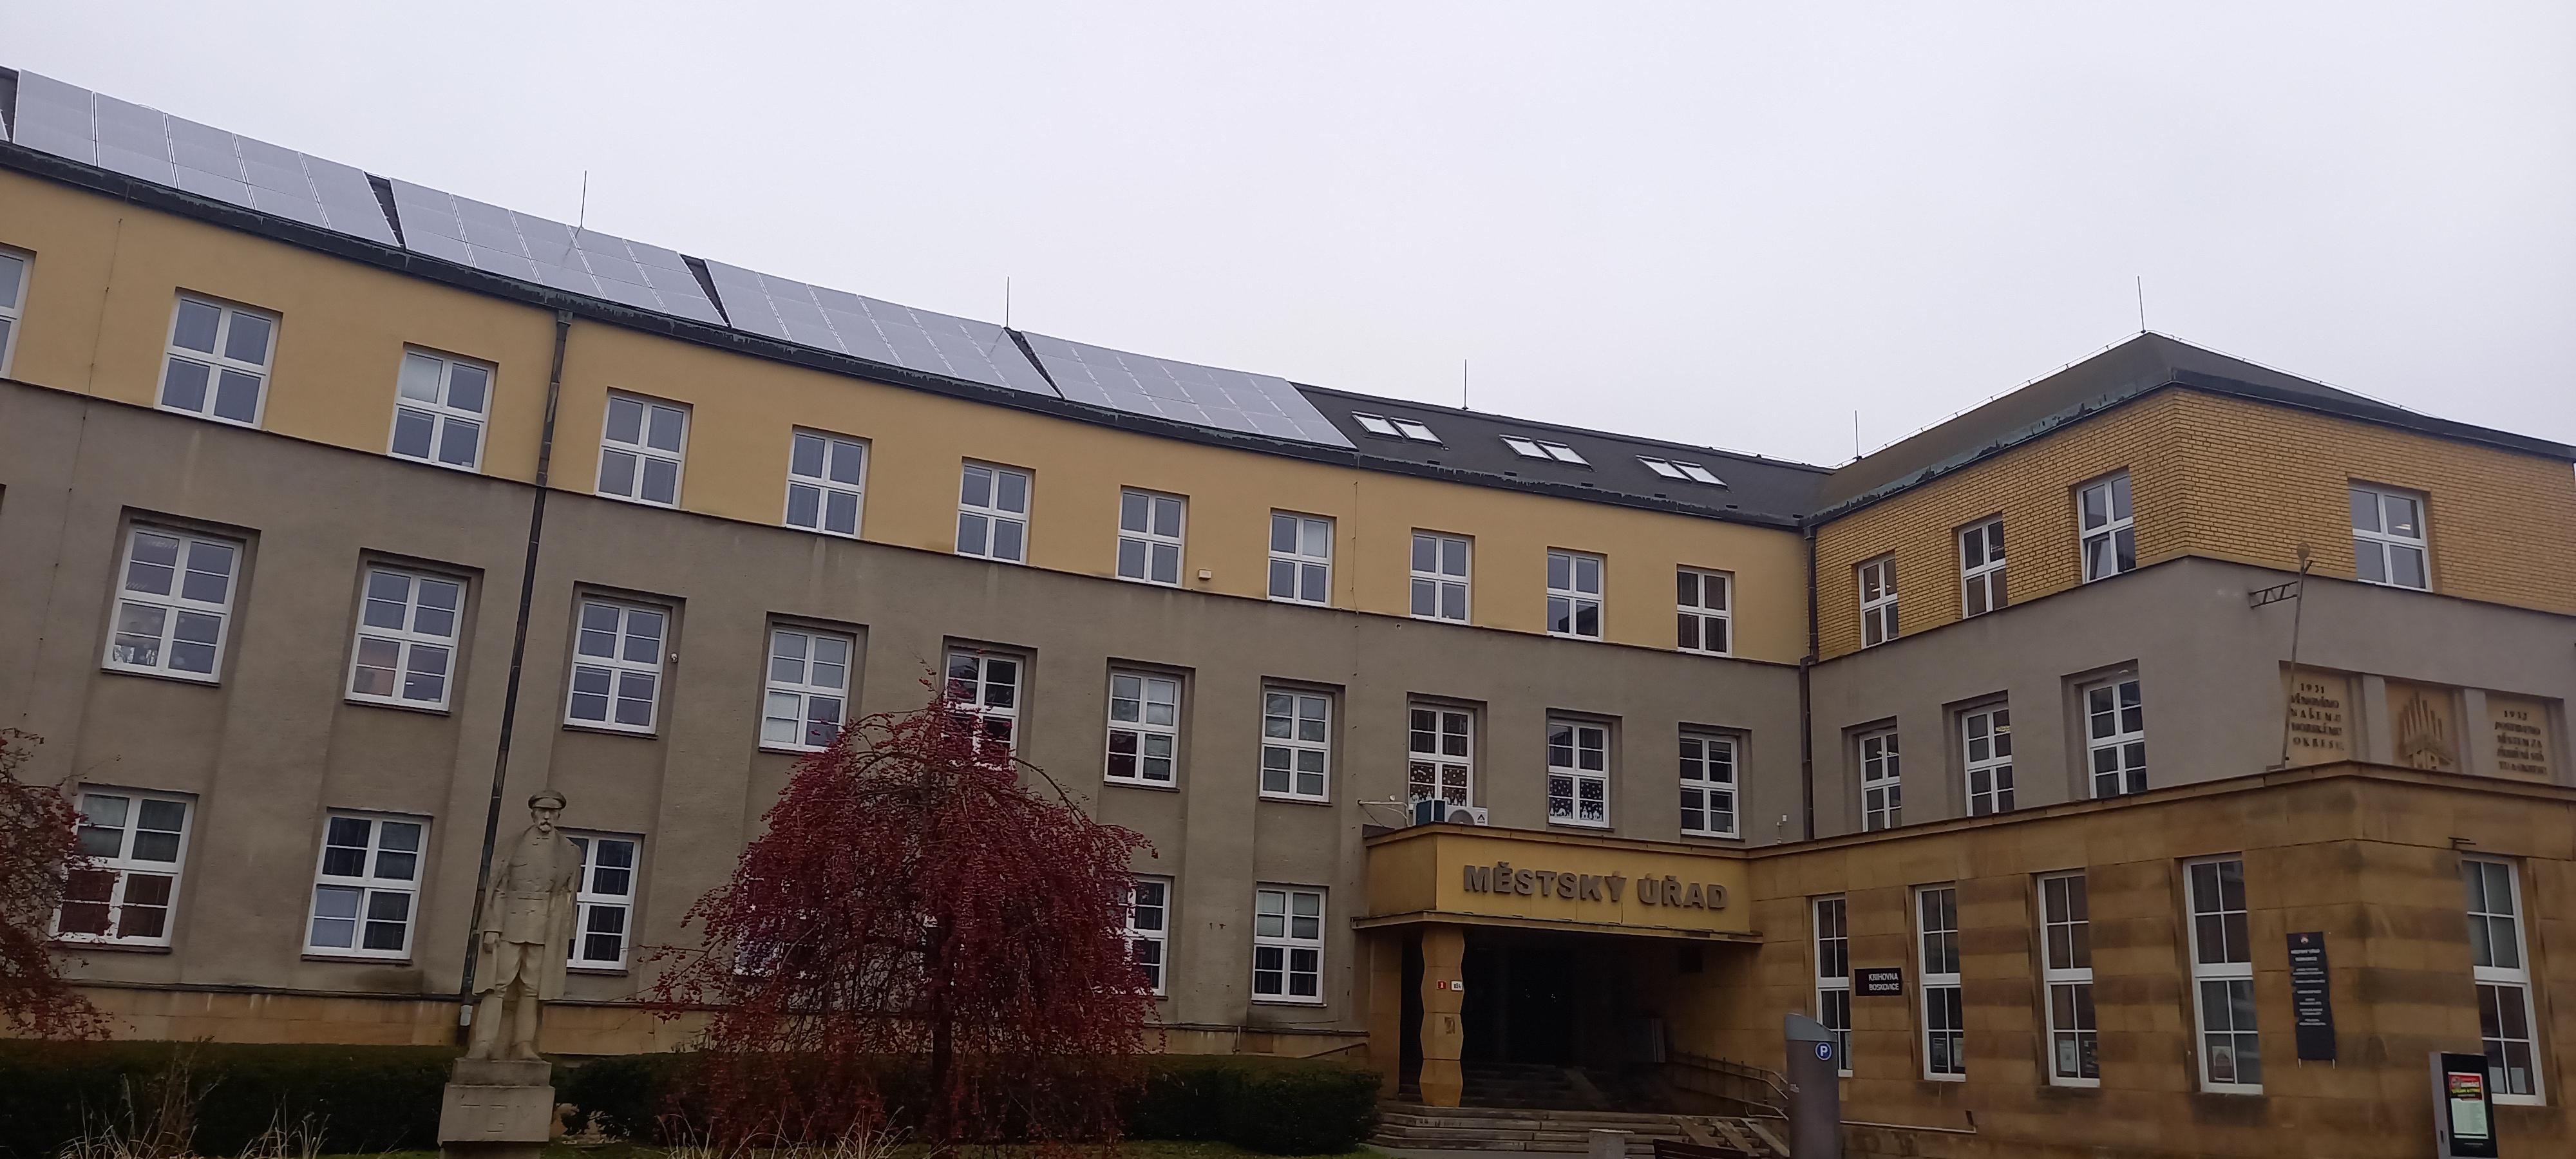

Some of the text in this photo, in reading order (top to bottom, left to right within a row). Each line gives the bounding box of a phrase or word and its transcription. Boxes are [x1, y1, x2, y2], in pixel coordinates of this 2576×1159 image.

[1463, 861, 1727, 909] MĚSTSKÝ ÚŘAD
[1868, 973, 1899, 981] KNIHOVNA
[1820, 1045, 1828, 1057] P
